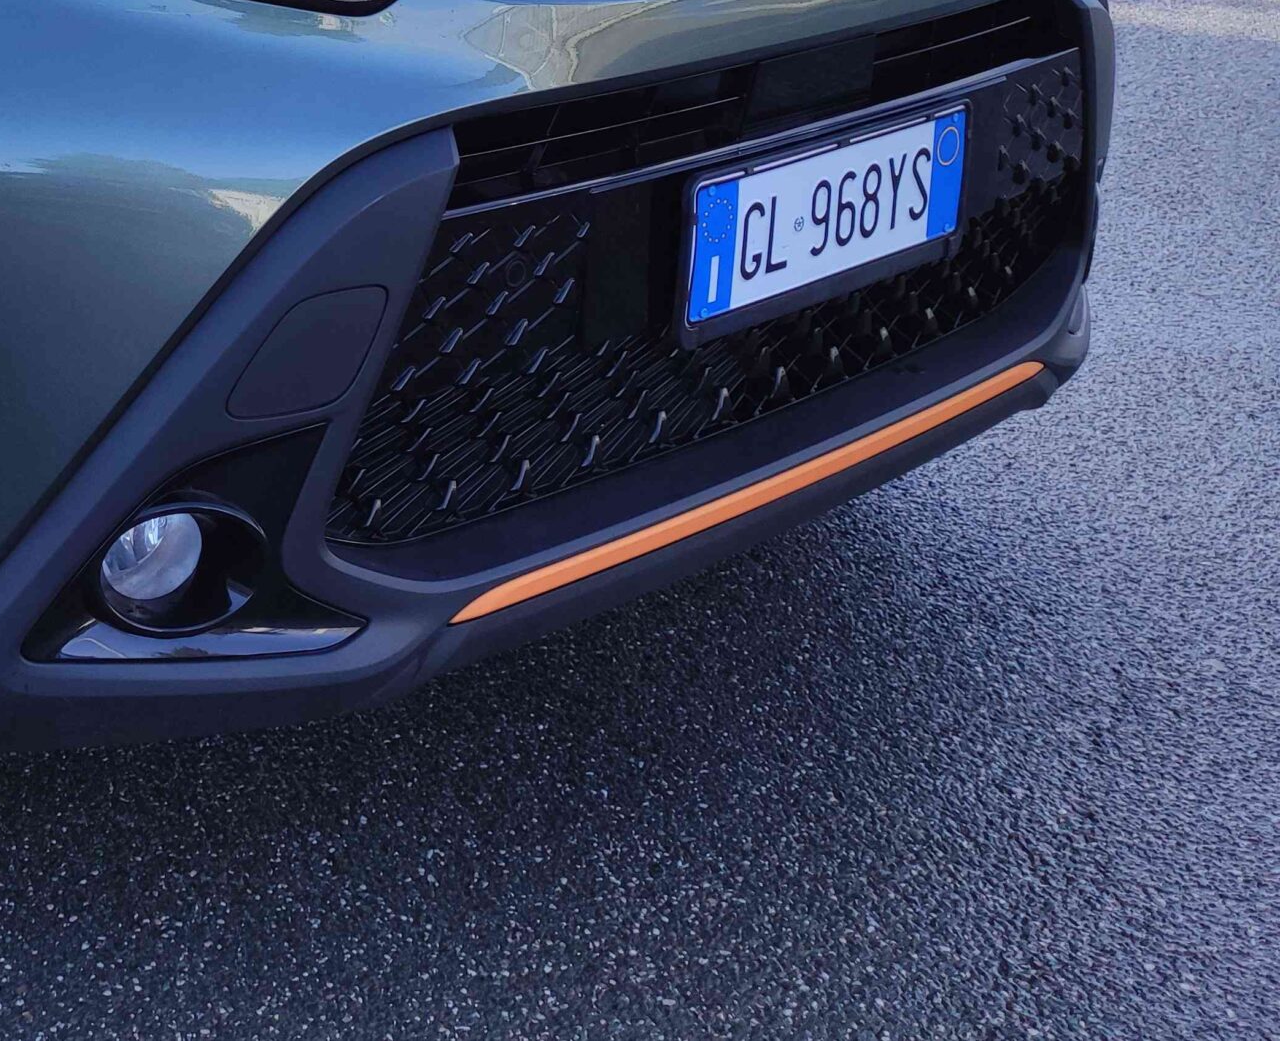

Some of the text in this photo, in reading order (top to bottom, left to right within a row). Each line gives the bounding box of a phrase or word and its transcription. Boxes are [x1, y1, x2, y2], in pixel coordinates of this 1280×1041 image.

[740, 147, 932, 281] GL 968YS
[707, 255, 720, 303] I
